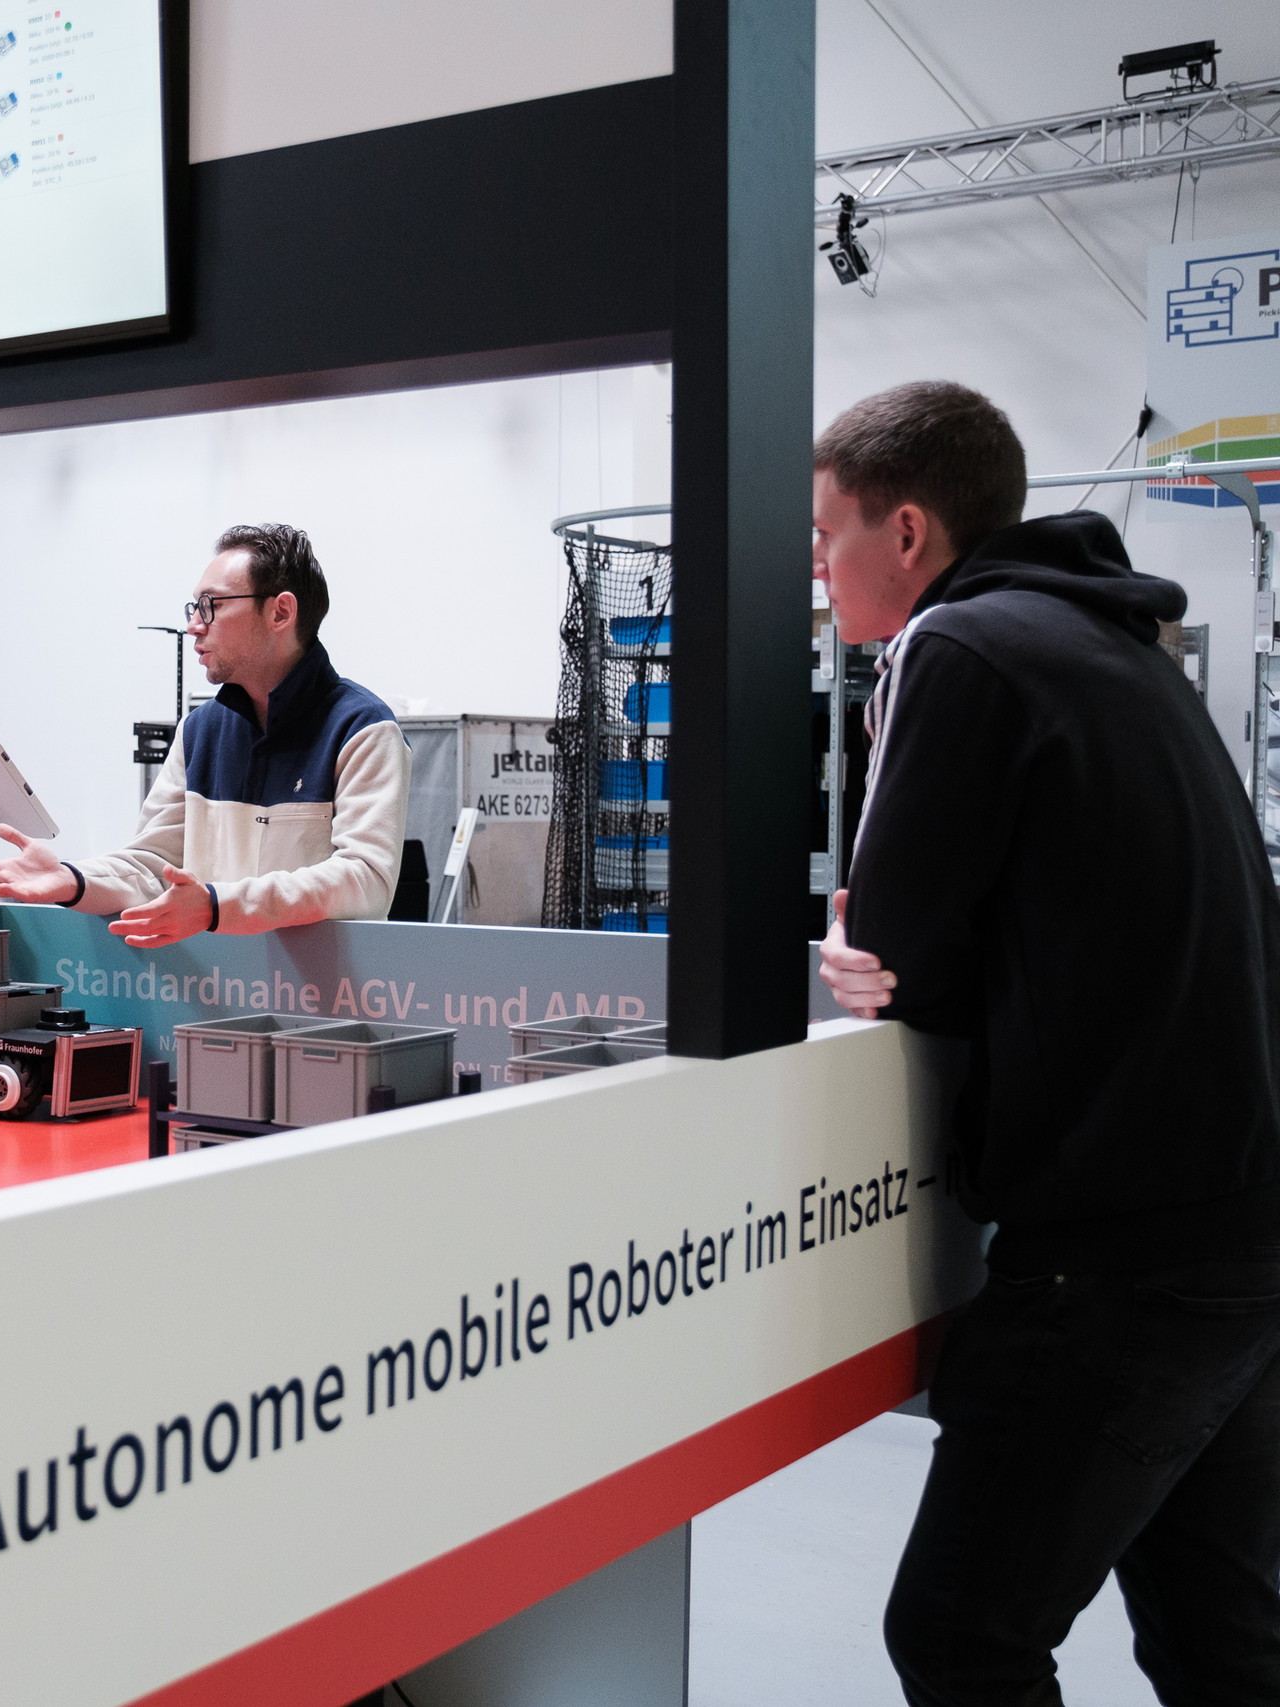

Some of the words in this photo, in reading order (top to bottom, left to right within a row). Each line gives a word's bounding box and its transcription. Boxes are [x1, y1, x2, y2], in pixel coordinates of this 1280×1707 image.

[477, 794, 509, 816] AKE
[56, 958, 321, 1014] Standardnahe
[331, 977, 429, 1020] AGV-
[444, 986, 528, 1027] und
[4, 1042, 43, 1055] Fraunhofer
[366, 1276, 551, 1417] mobile
[567, 1227, 734, 1341] Roboter
[745, 1200, 787, 1273] im
[799, 1160, 909, 1253] Einsatz
